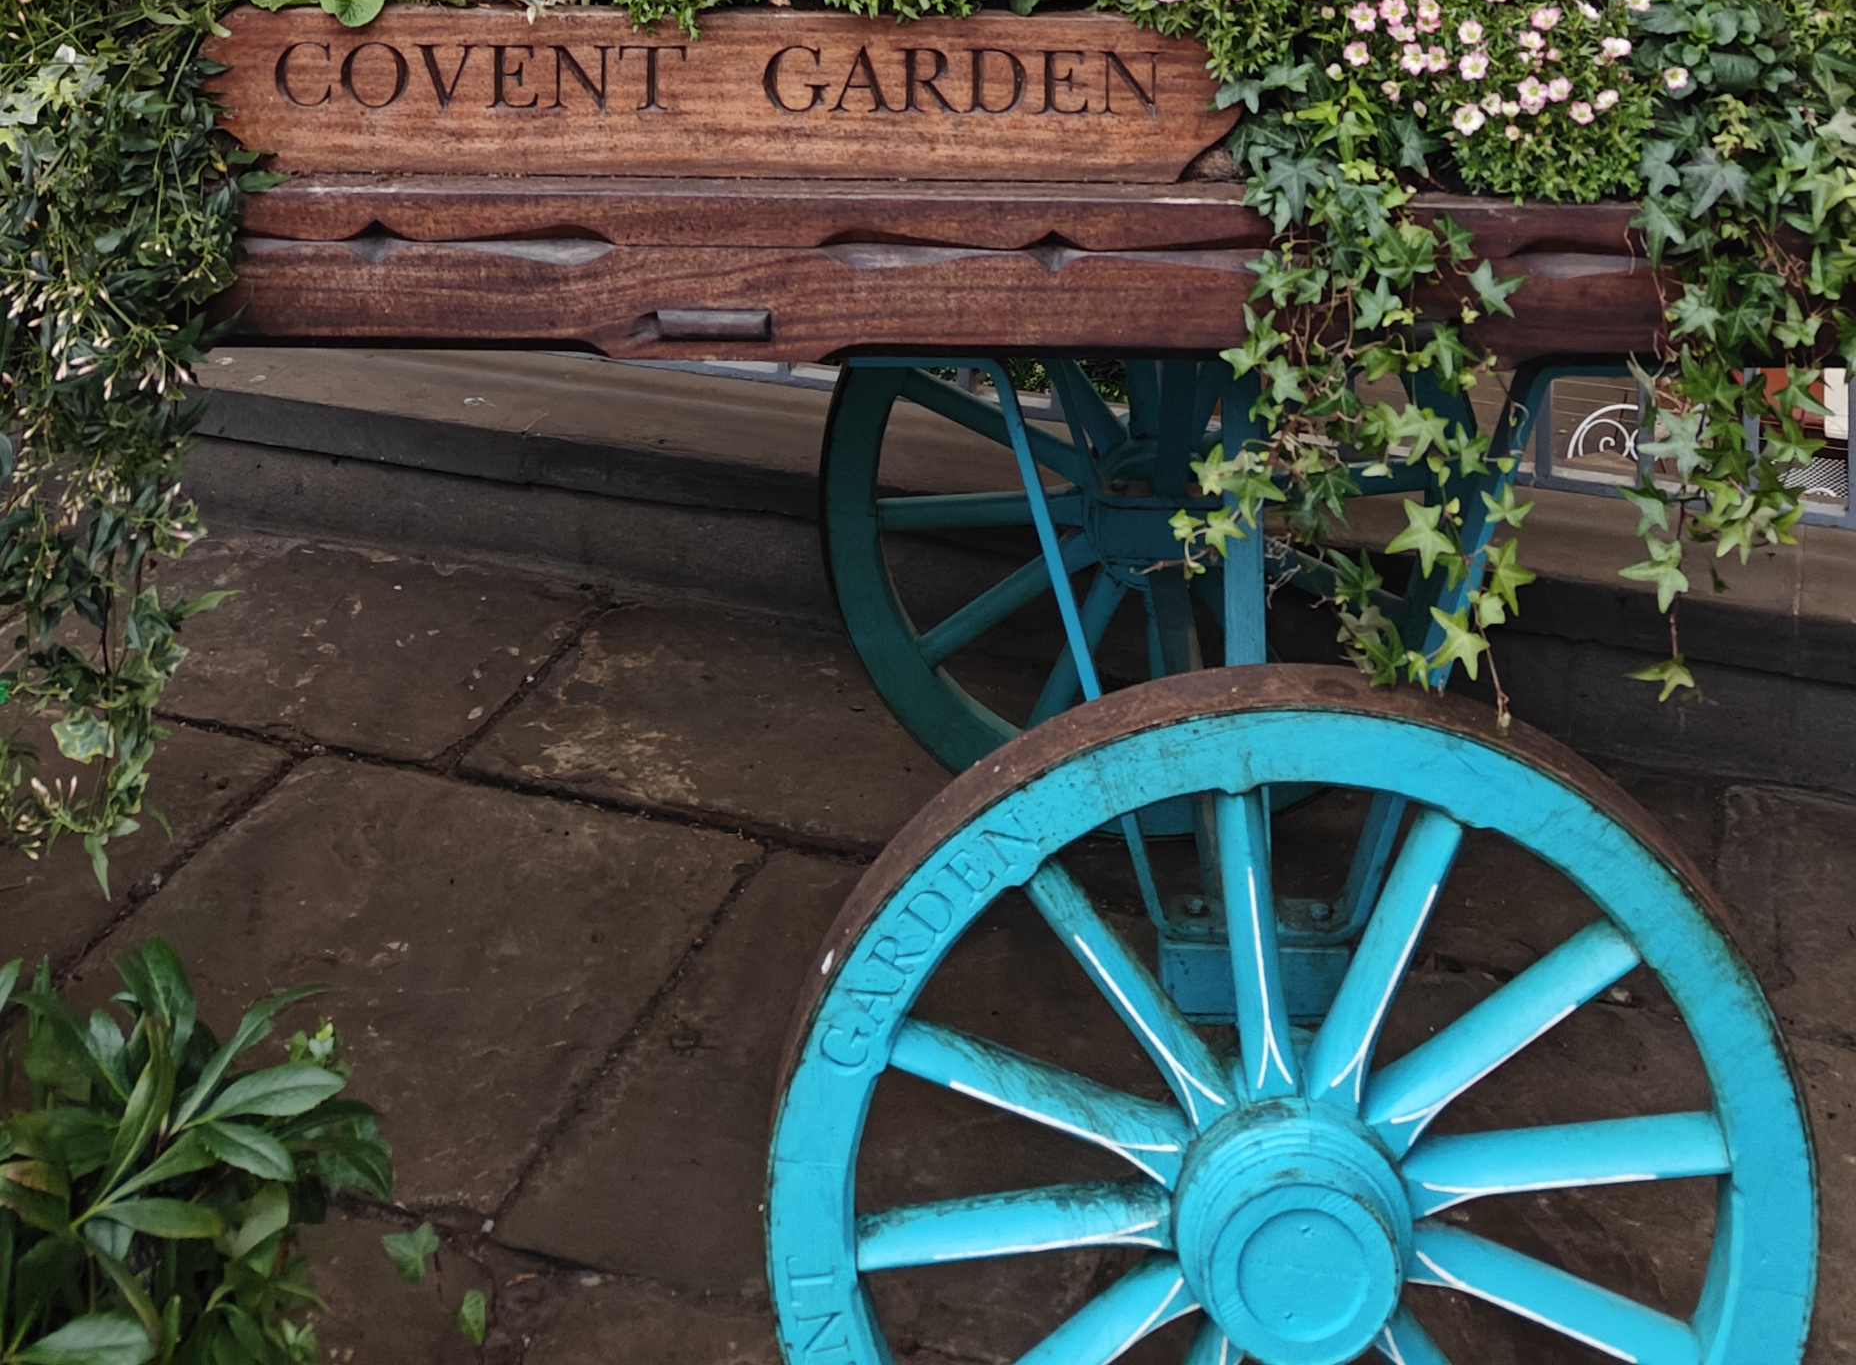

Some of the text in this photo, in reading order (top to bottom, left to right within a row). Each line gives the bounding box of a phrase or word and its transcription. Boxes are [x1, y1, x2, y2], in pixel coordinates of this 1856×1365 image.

[274, 41, 1159, 117] COVENT GARDEN
[820, 808, 1040, 1072] GARDEN
